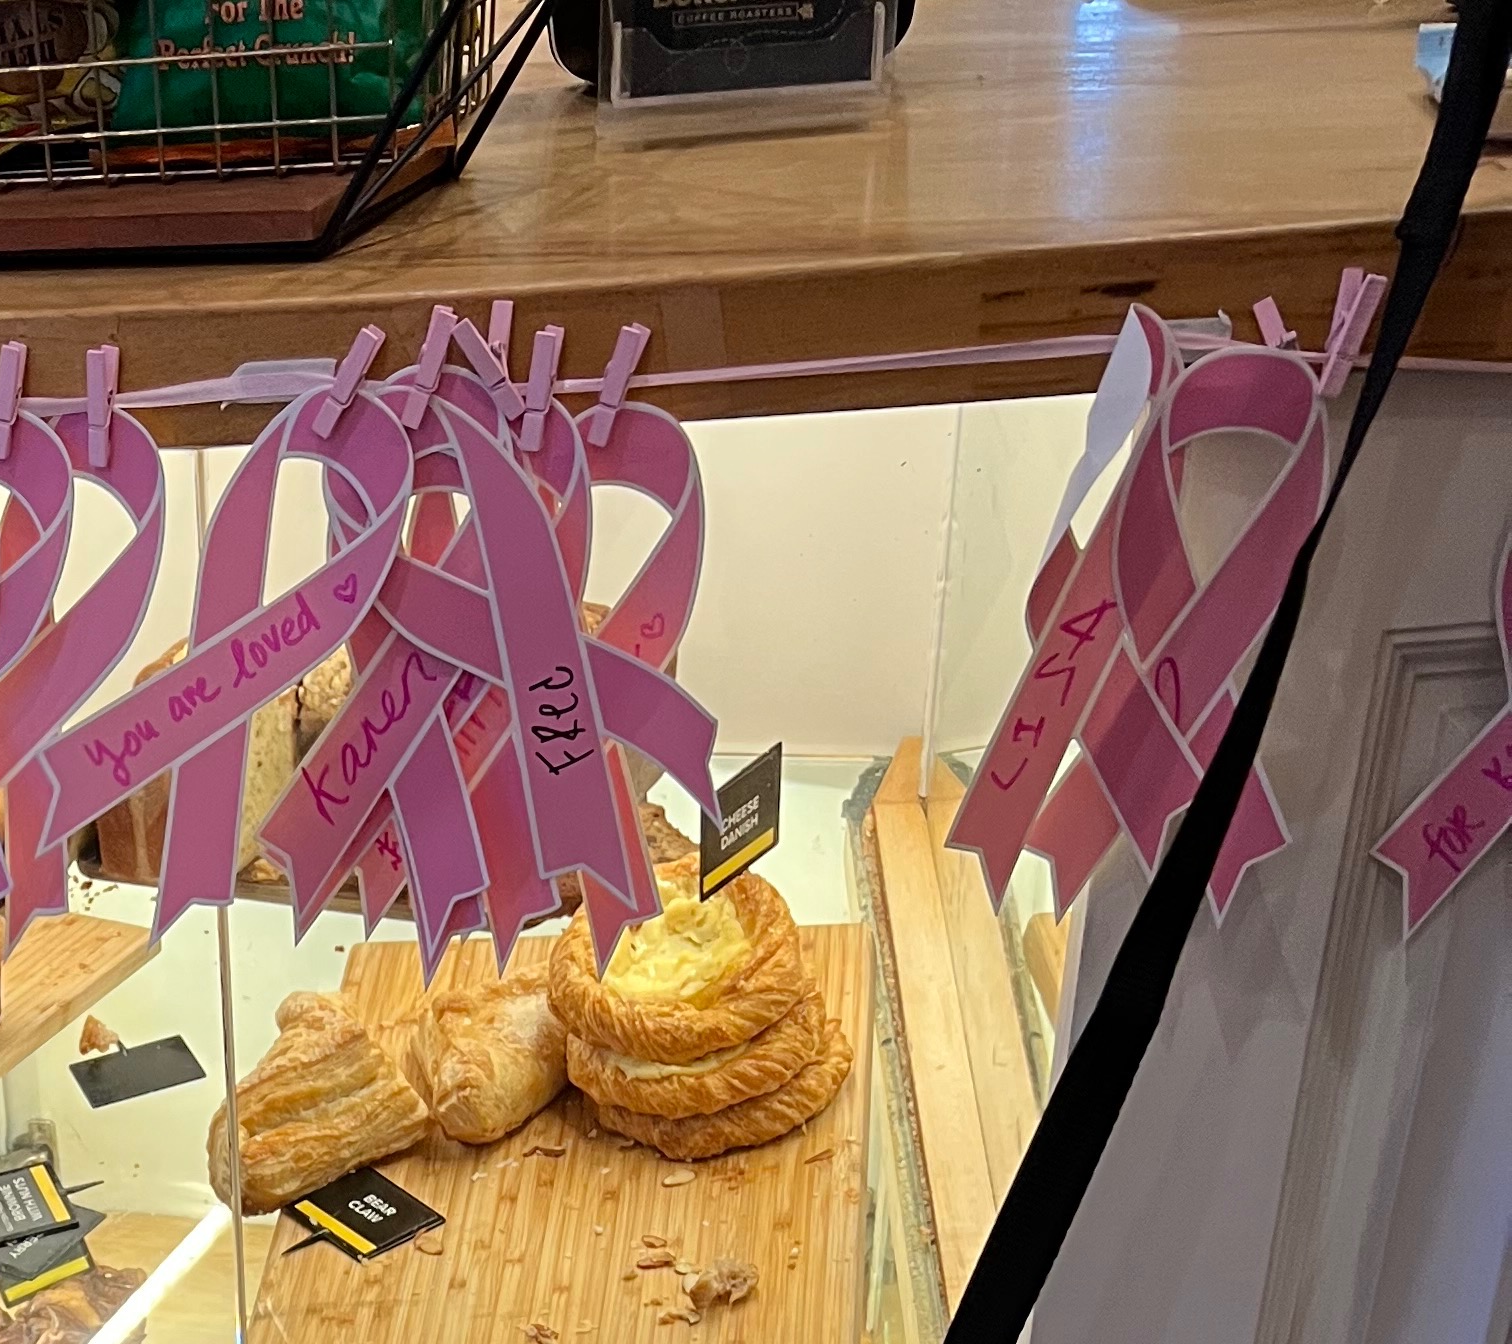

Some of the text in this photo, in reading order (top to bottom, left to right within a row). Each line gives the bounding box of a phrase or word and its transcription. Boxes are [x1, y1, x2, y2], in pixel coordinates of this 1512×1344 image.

[168, 676, 222, 722] are
[232, 590, 321, 689] loved
[990, 598, 1119, 791] LISA
[720, 812, 759, 851] DANISH
[722, 794, 760, 832] CHEESE
[12, 1176, 33, 1201] NUTS
[363, 1193, 397, 1217] BEAR
[348, 1200, 384, 1223] CLAW
